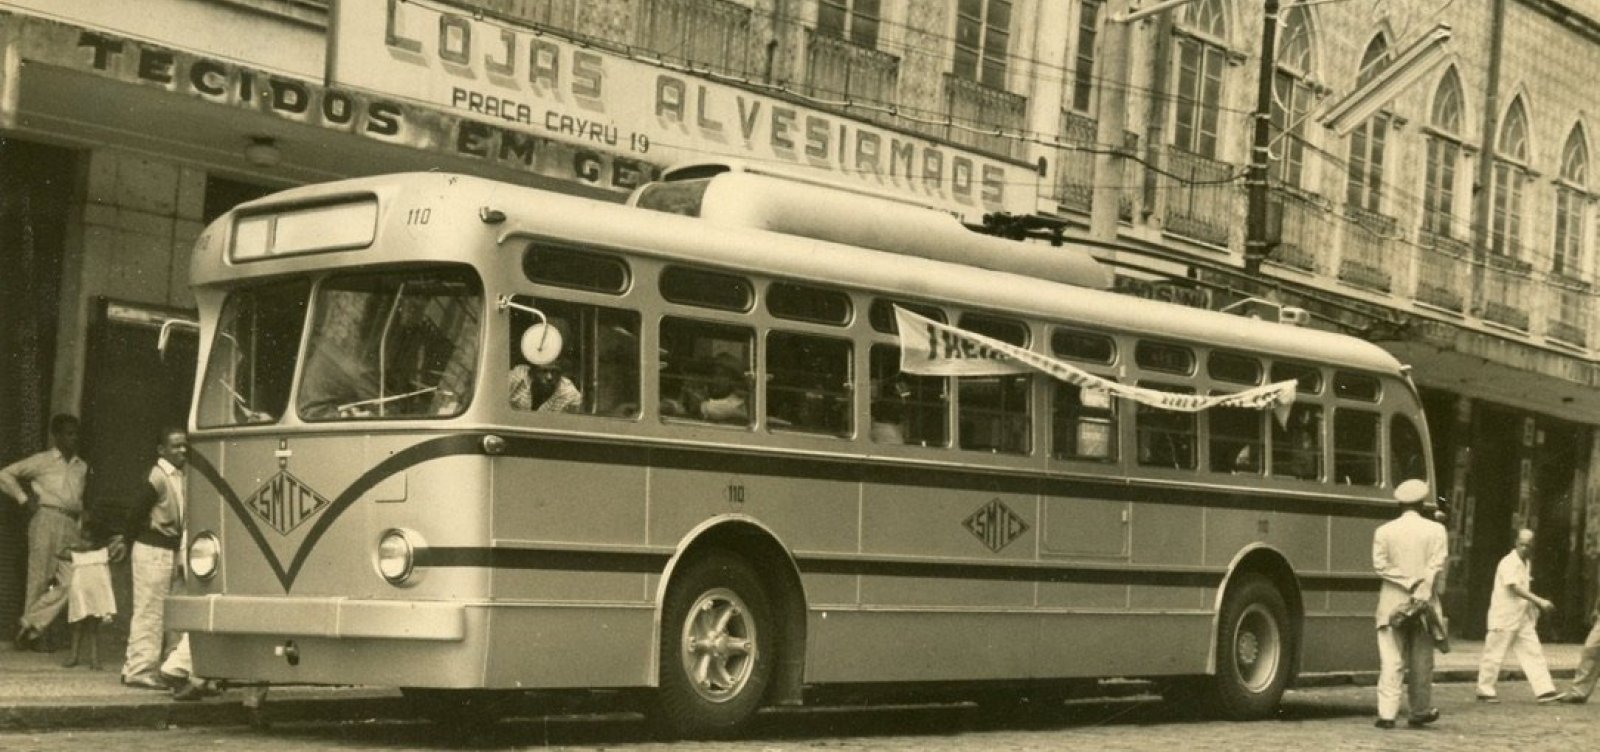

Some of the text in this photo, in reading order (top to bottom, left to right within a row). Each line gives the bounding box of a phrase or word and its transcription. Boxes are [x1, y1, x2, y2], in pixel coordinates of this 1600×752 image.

[384, 0, 604, 99] LOJAS
[77, 30, 403, 136] TECIDOS
[457, 119, 536, 166] EM
[630, 132, 649, 154] 19
[406, 208, 432, 225] 110
[257, 471, 313, 533] SMTC
[728, 485, 745, 503] 110
[975, 500, 1018, 550] SMTC
